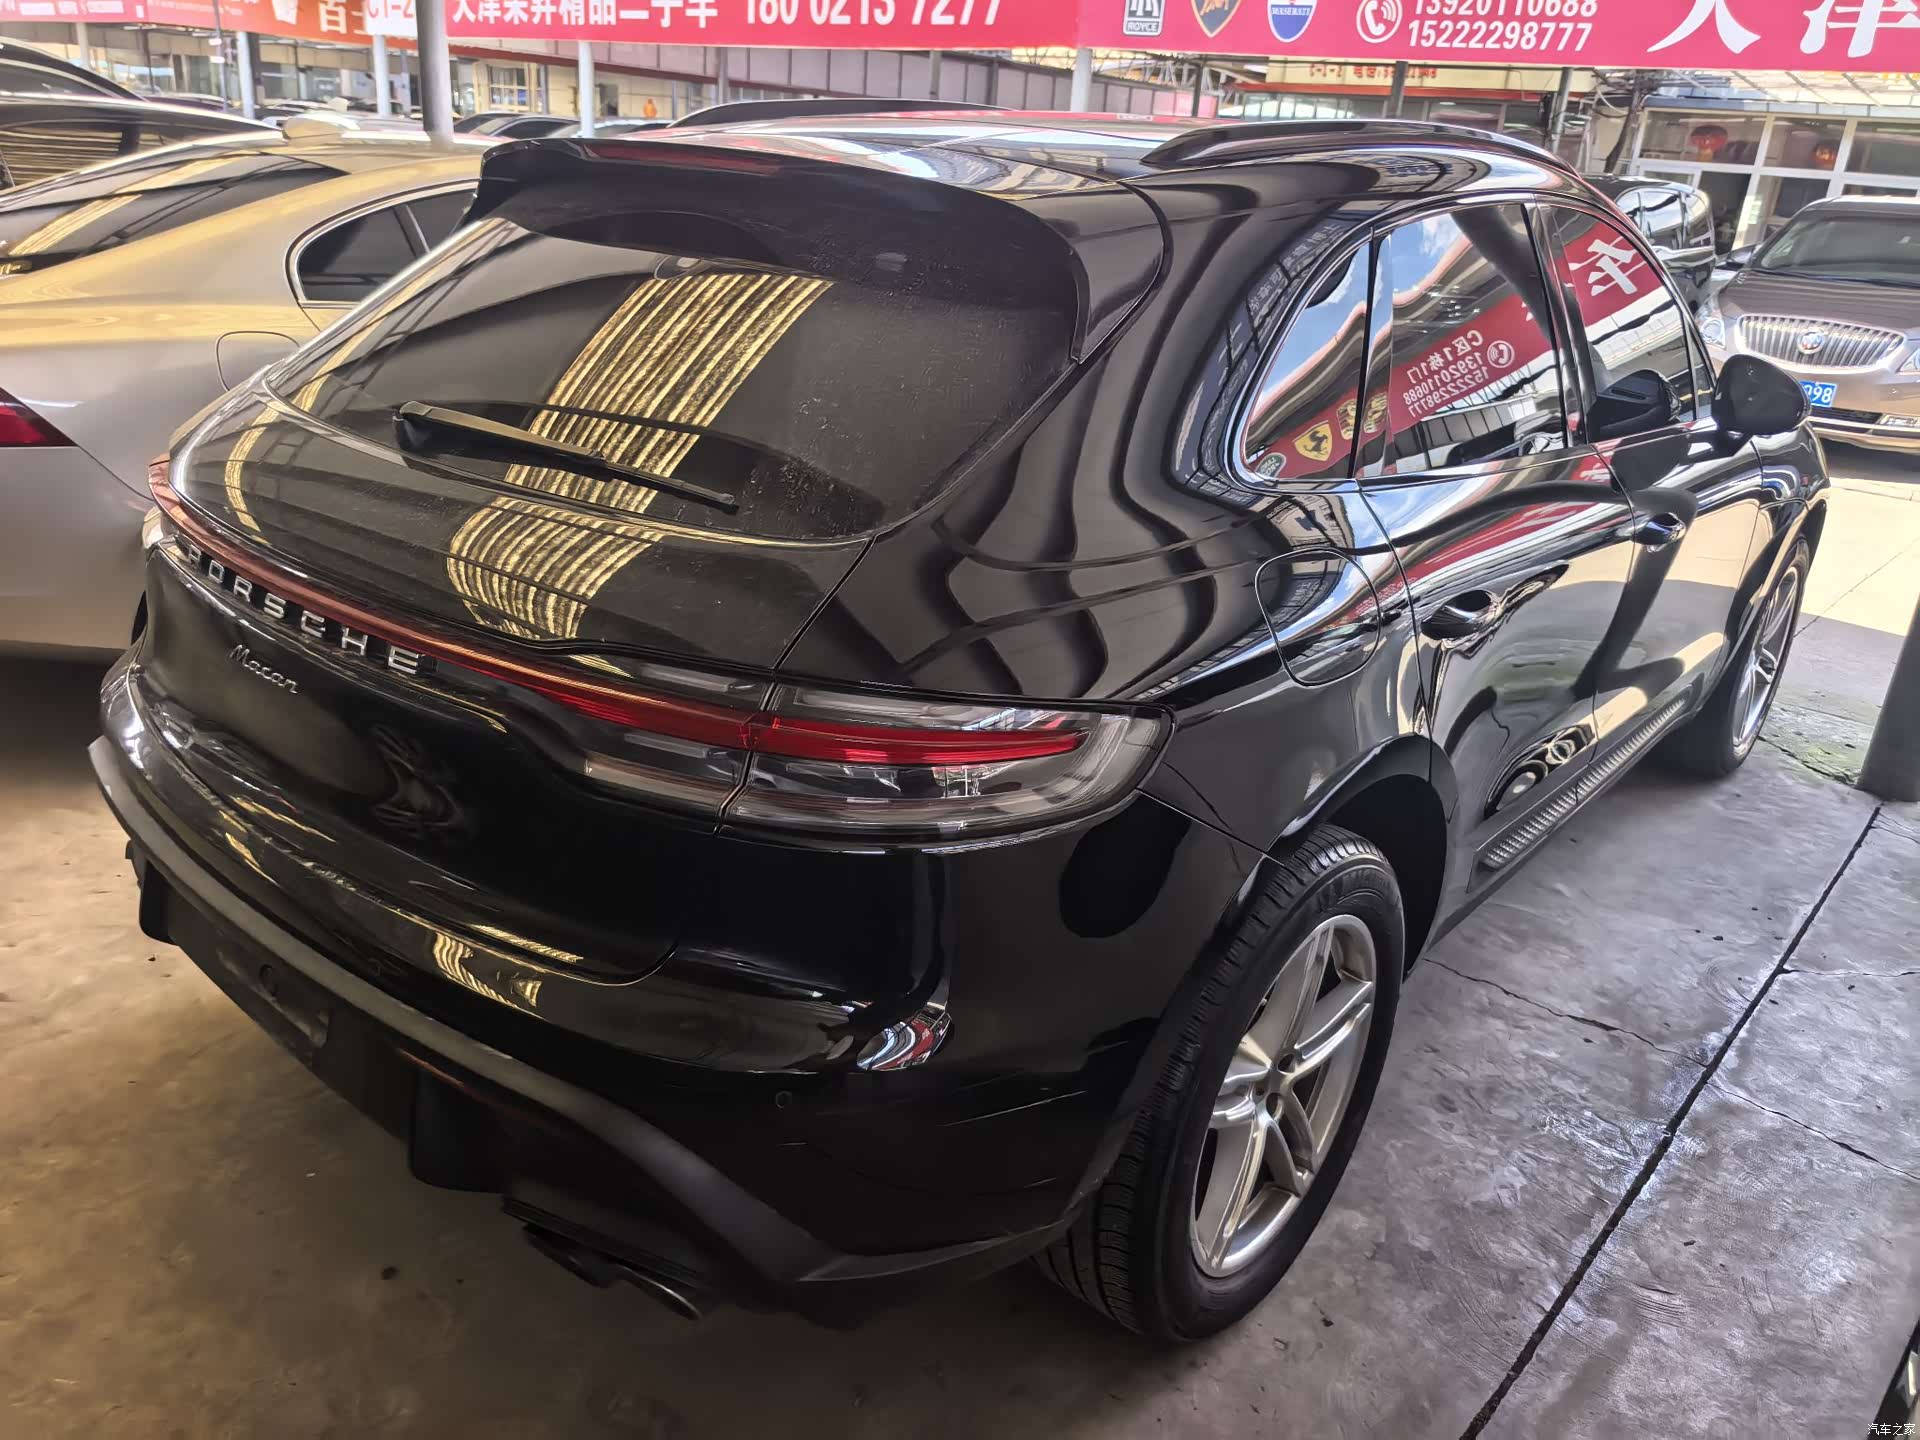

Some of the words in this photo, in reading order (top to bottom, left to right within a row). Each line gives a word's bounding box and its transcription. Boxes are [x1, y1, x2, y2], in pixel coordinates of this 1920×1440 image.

[1408, 20, 1593, 51] 15222298777
[188, 544, 419, 676] PORSCHE
[227, 644, 298, 694] Macan
